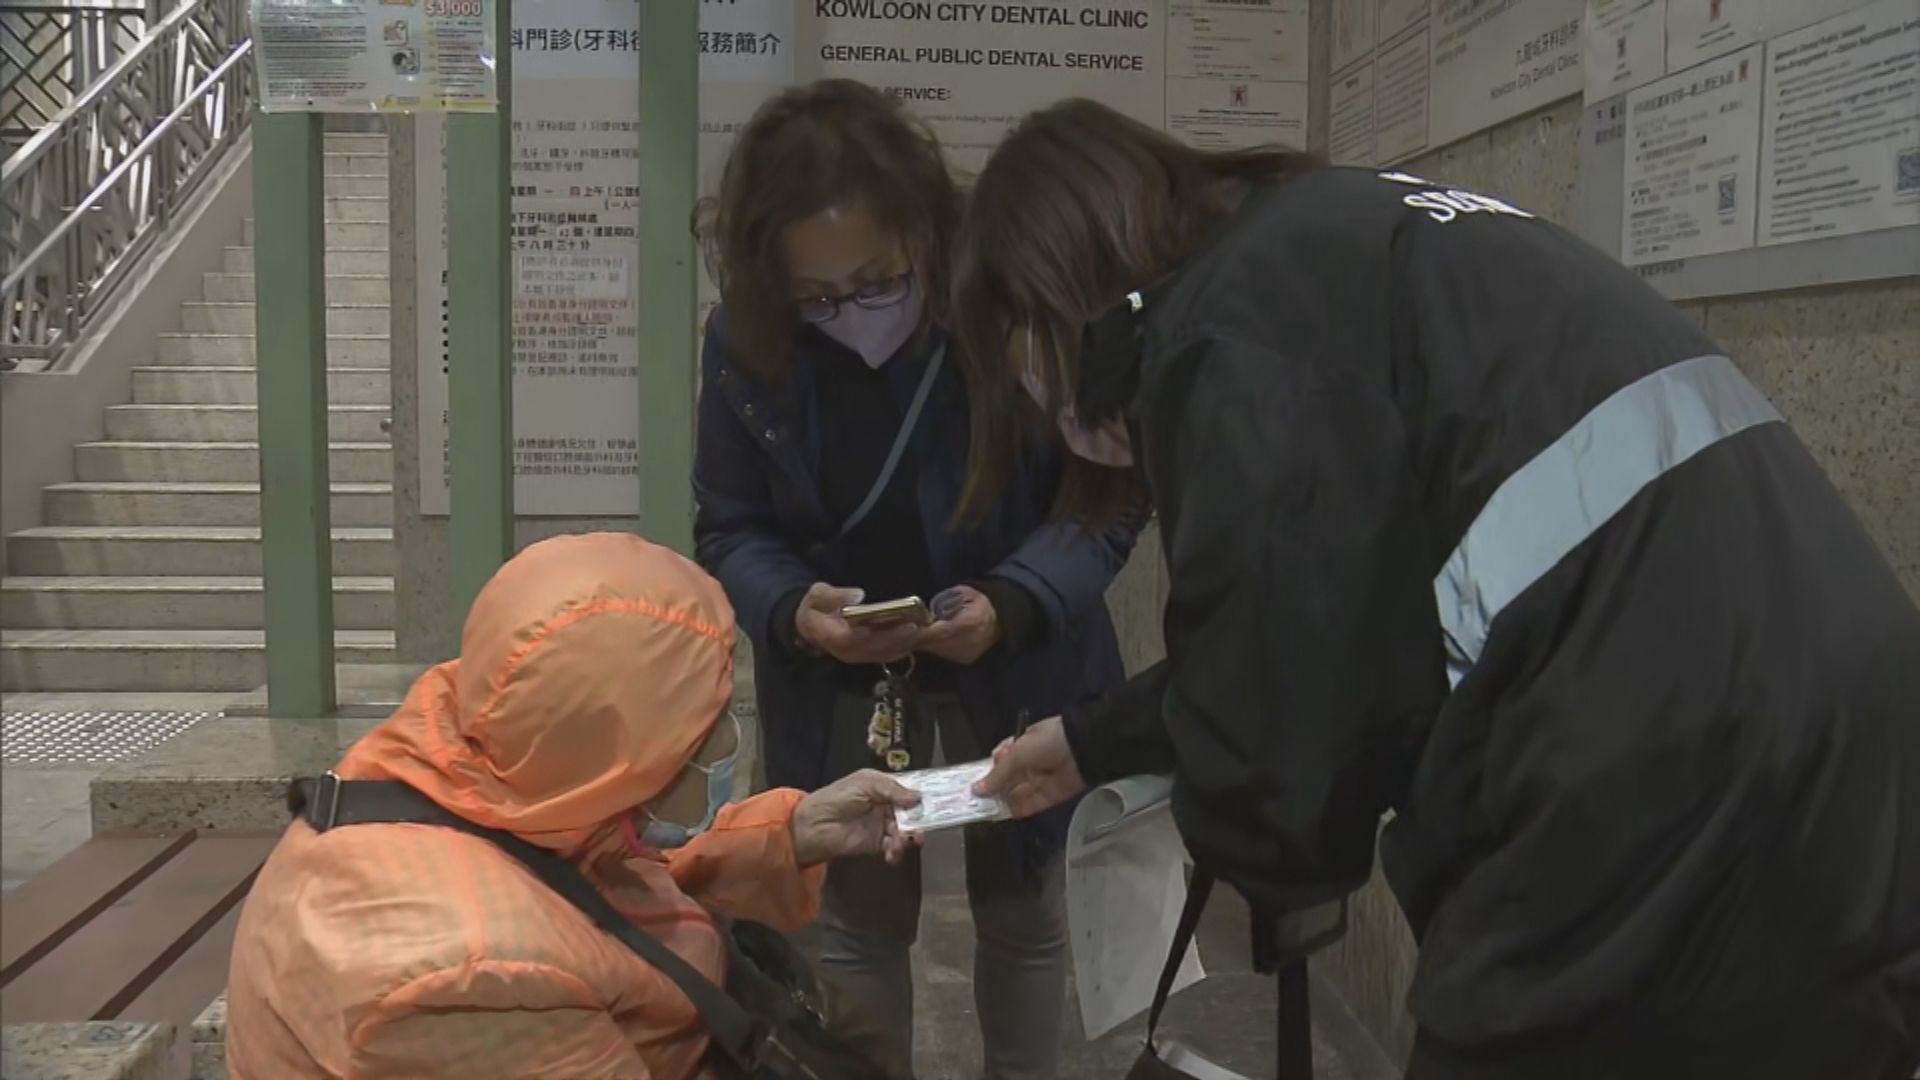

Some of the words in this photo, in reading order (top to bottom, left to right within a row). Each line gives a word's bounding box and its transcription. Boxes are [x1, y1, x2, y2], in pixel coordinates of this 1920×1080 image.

[816, 0, 931, 20] KOWLOON
[936, 4, 987, 22] CITY
[992, 6, 1075, 25] DENTAL
[1080, 8, 1149, 29] CLINIC
[820, 45, 910, 62] GENERAL
[915, 48, 983, 65] PUBLIC
[988, 49, 1060, 67] DENTAL
[1064, 52, 1143, 71] SERVICE
